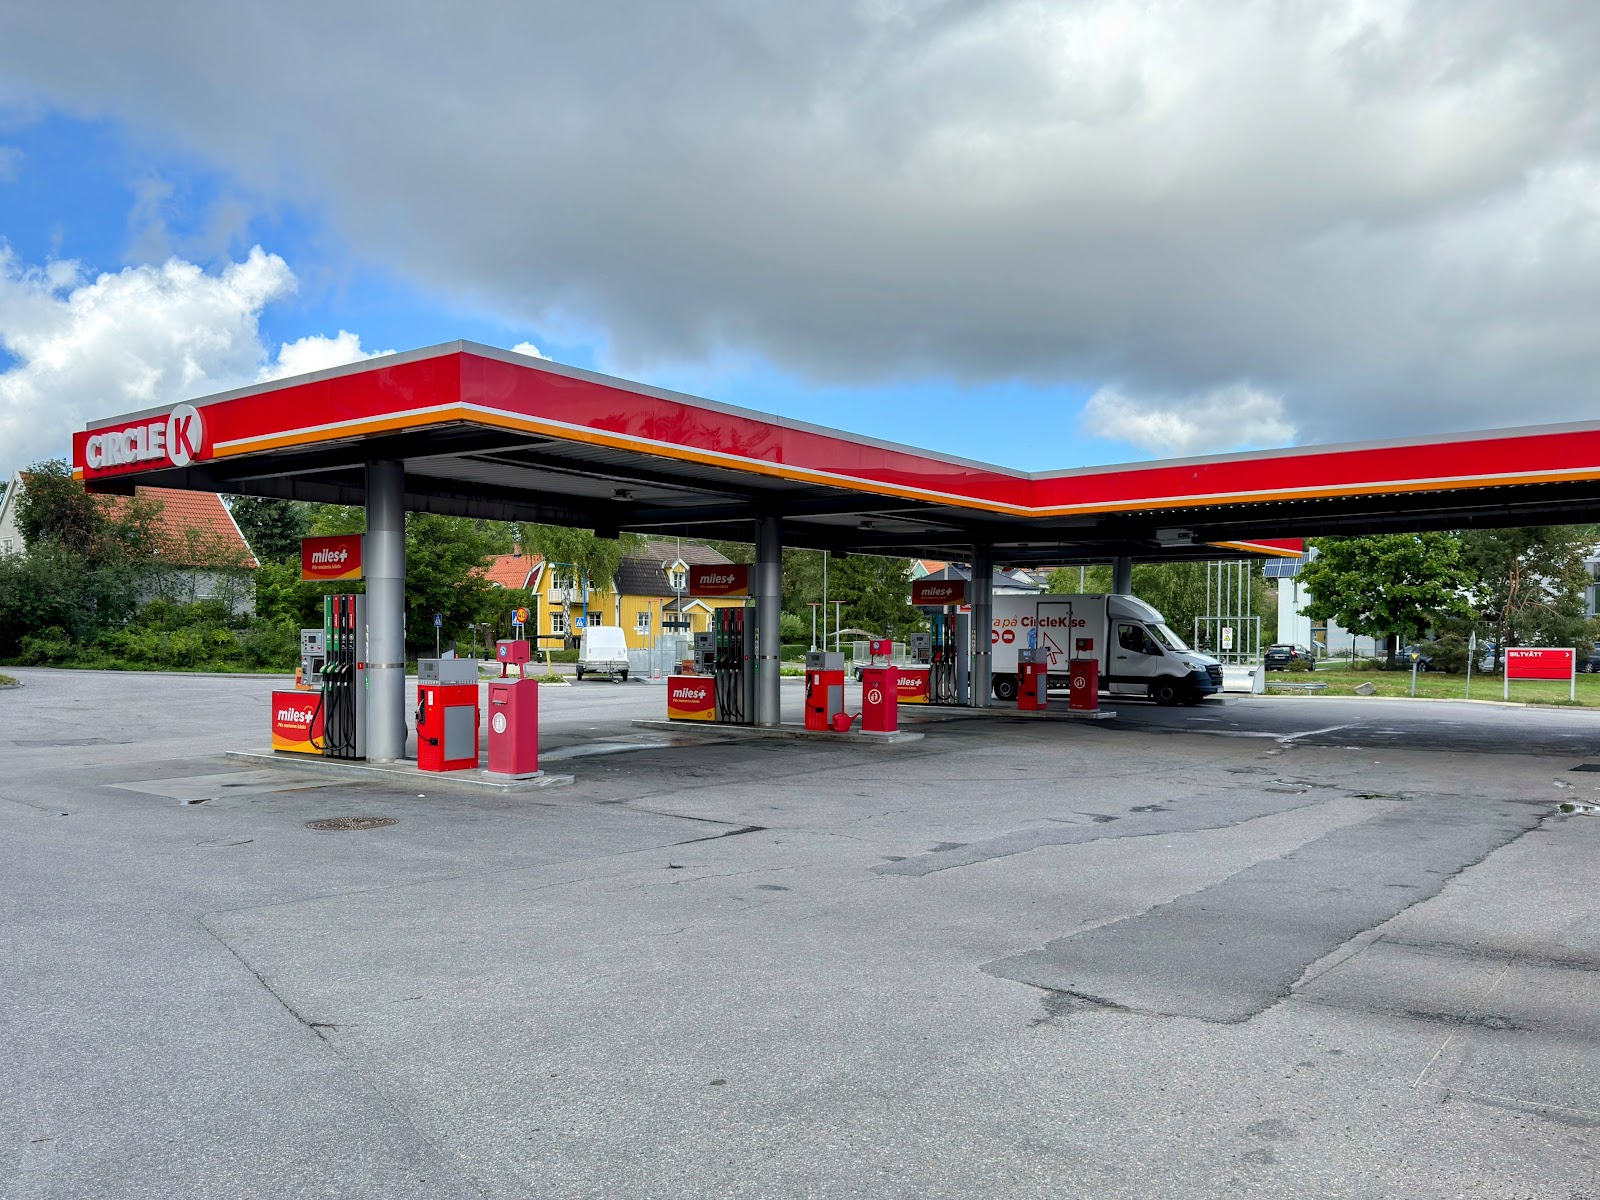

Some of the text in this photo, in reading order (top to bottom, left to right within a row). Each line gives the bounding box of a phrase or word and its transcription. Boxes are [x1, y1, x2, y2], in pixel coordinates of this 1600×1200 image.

[86, 413, 199, 469] CIRCLE K
[312, 548, 348, 563] miles+
[700, 573, 735, 584] miles+
[921, 587, 953, 596] miles+
[1002, 615, 1018, 629] på
[673, 688, 706, 699] miles+
[278, 708, 313, 723] miles+
